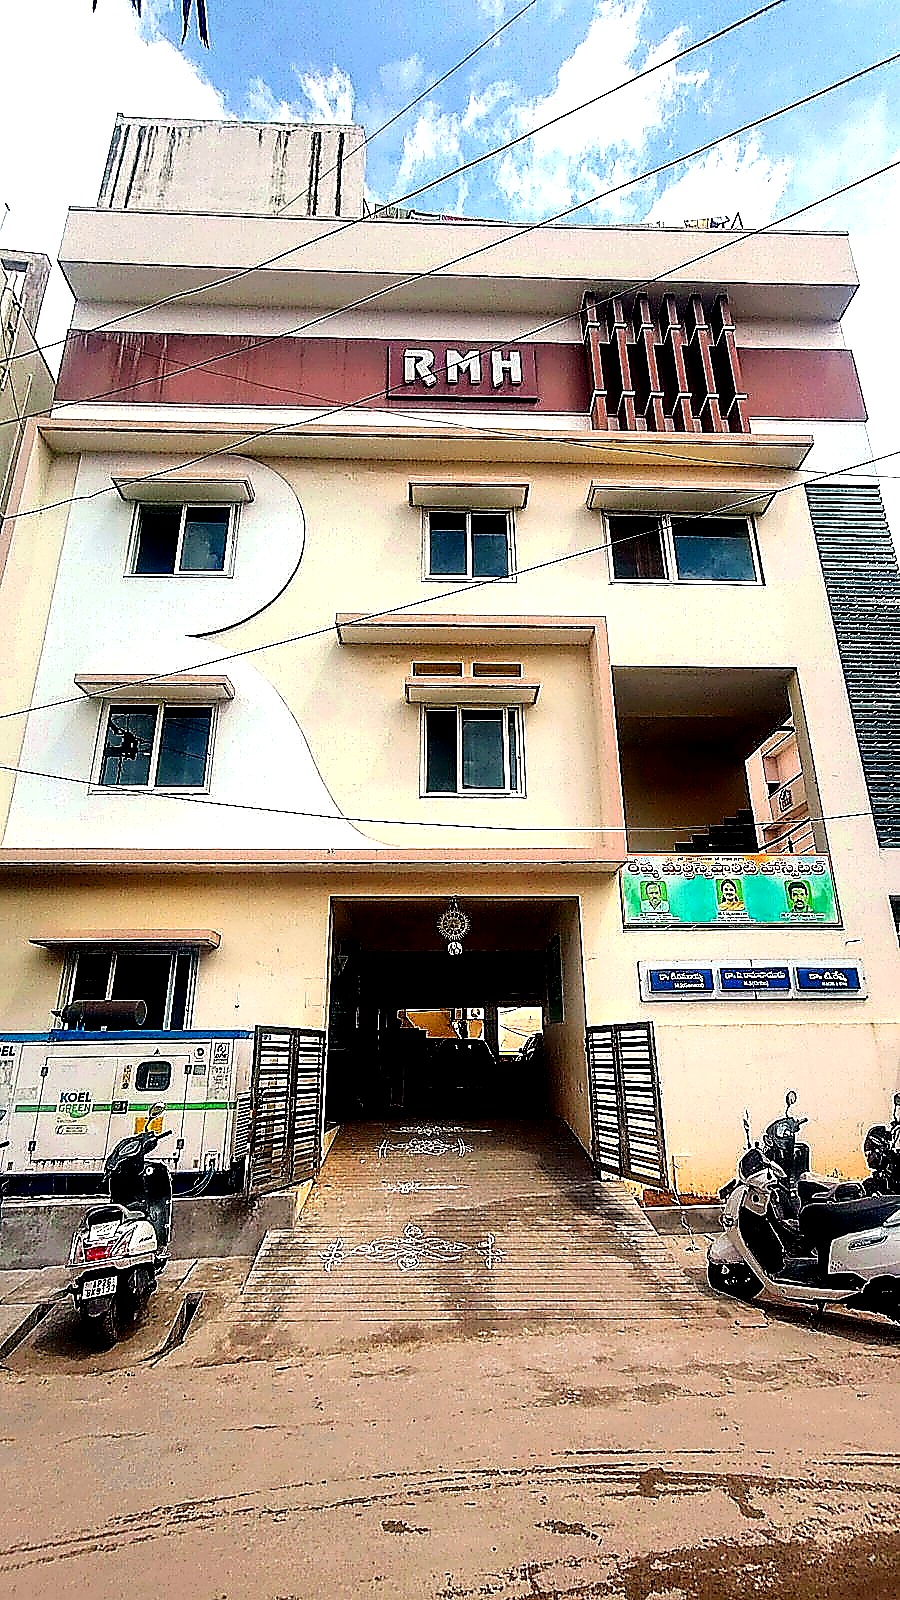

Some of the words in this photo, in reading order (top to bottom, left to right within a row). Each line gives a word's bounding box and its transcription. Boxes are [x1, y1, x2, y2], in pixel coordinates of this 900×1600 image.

[403, 348, 523, 388] RMH
[60, 1092, 92, 1103] KOEL
[58, 1103, 91, 1113] GREEN
